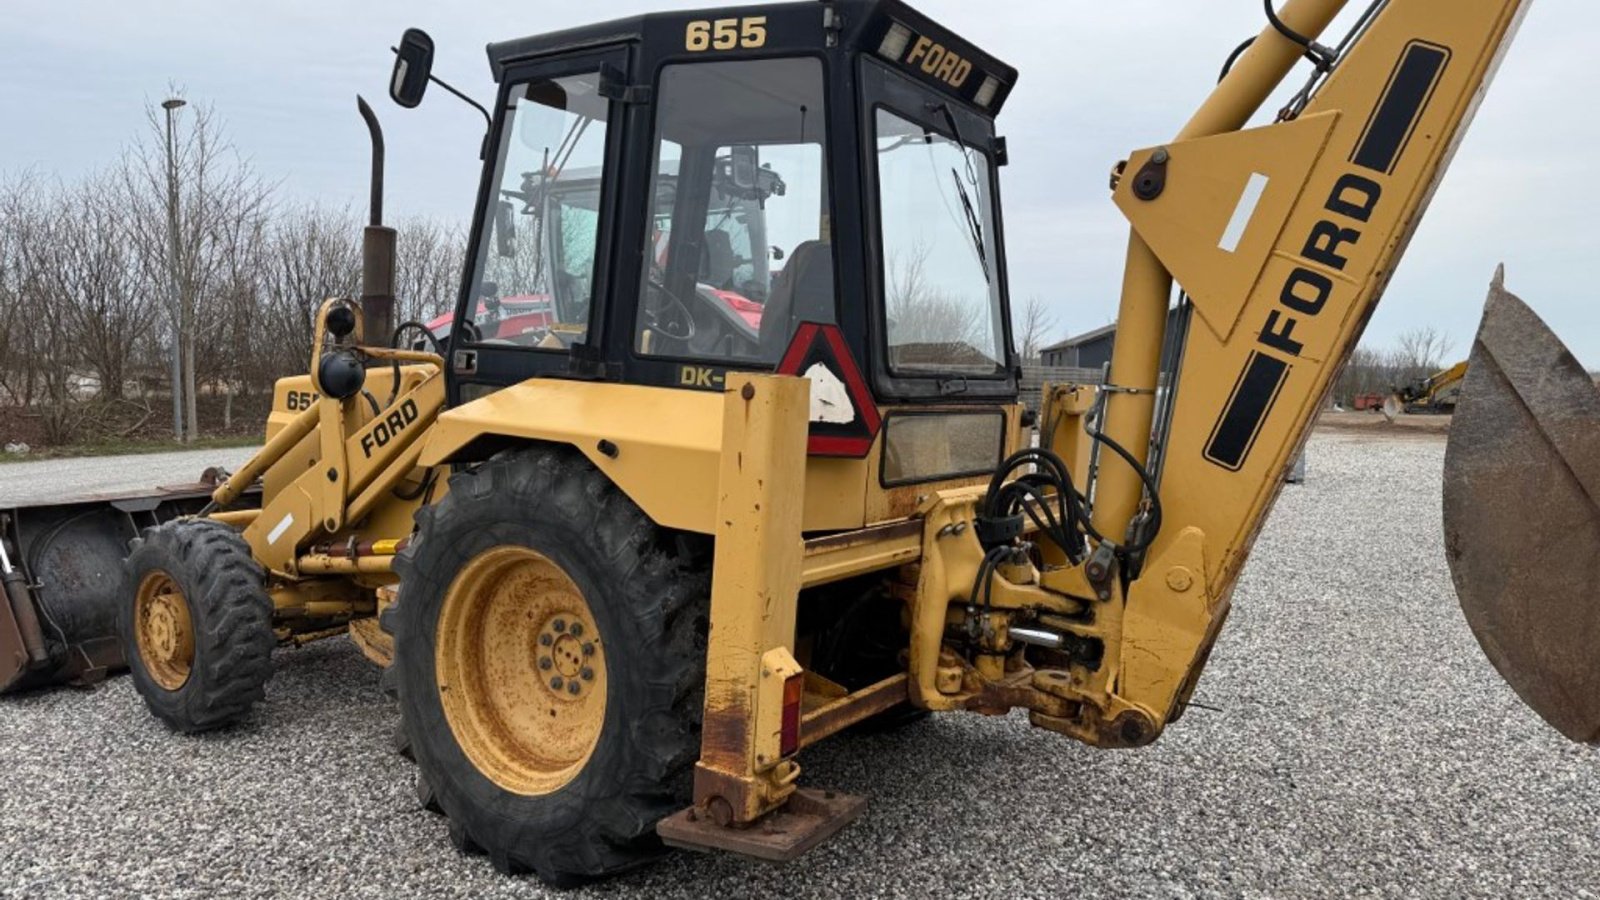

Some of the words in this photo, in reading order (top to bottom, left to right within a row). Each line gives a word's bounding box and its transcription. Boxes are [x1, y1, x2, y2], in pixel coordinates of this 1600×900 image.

[685, 16, 767, 51] 655
[906, 35, 972, 88] FORD
[1257, 173, 1382, 357] FORD
[360, 398, 418, 459] FORD
